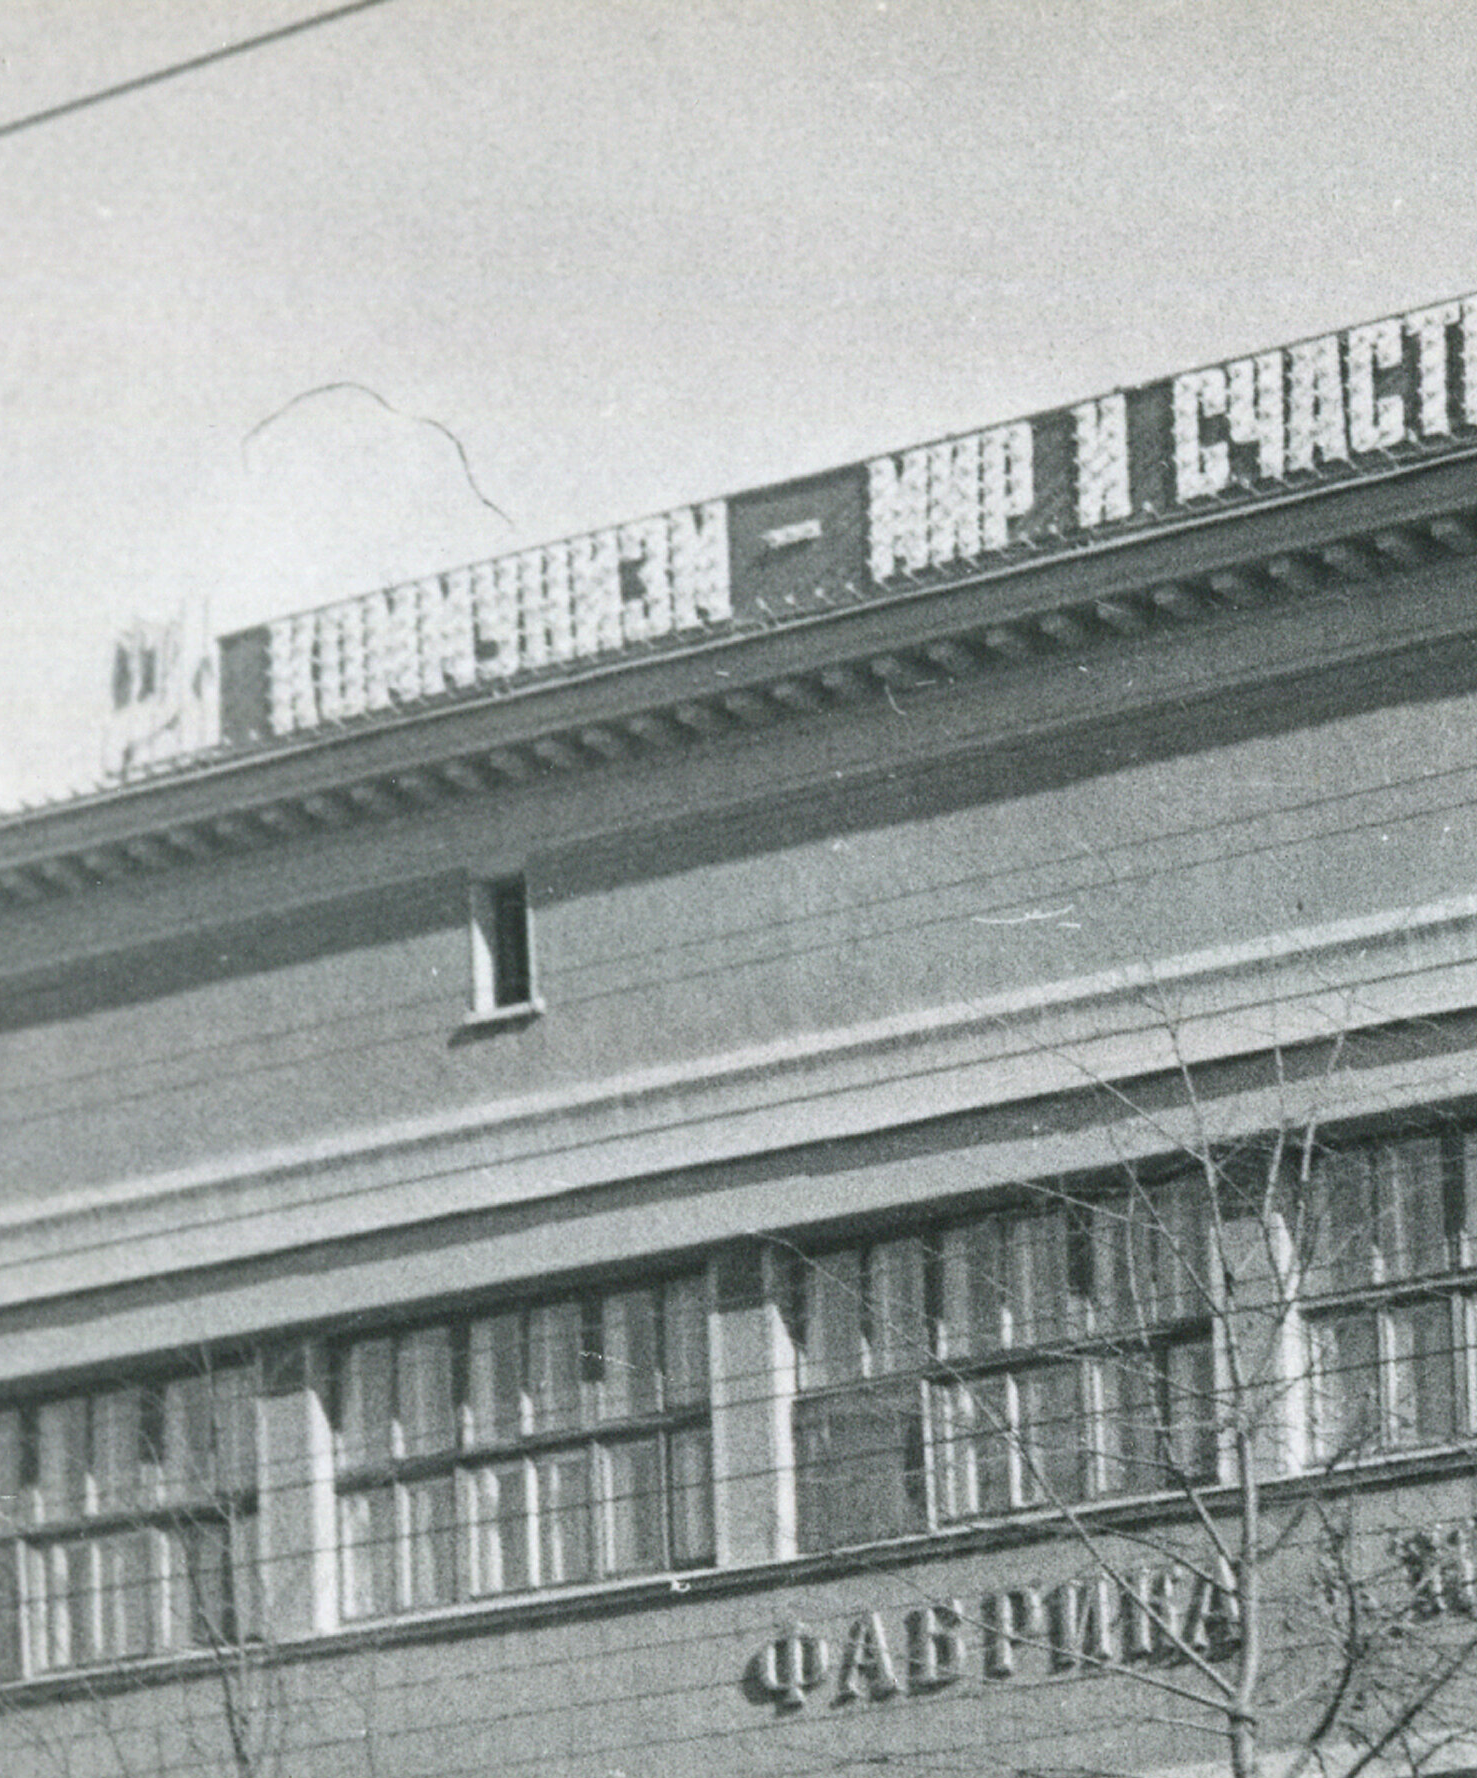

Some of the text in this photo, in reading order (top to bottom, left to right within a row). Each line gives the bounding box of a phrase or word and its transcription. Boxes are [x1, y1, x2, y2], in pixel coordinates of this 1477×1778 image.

[267, 497, 732, 738] КОММУНИЗМ
[867, 420, 1034, 584] МИР
[1071, 392, 1132, 528] И
